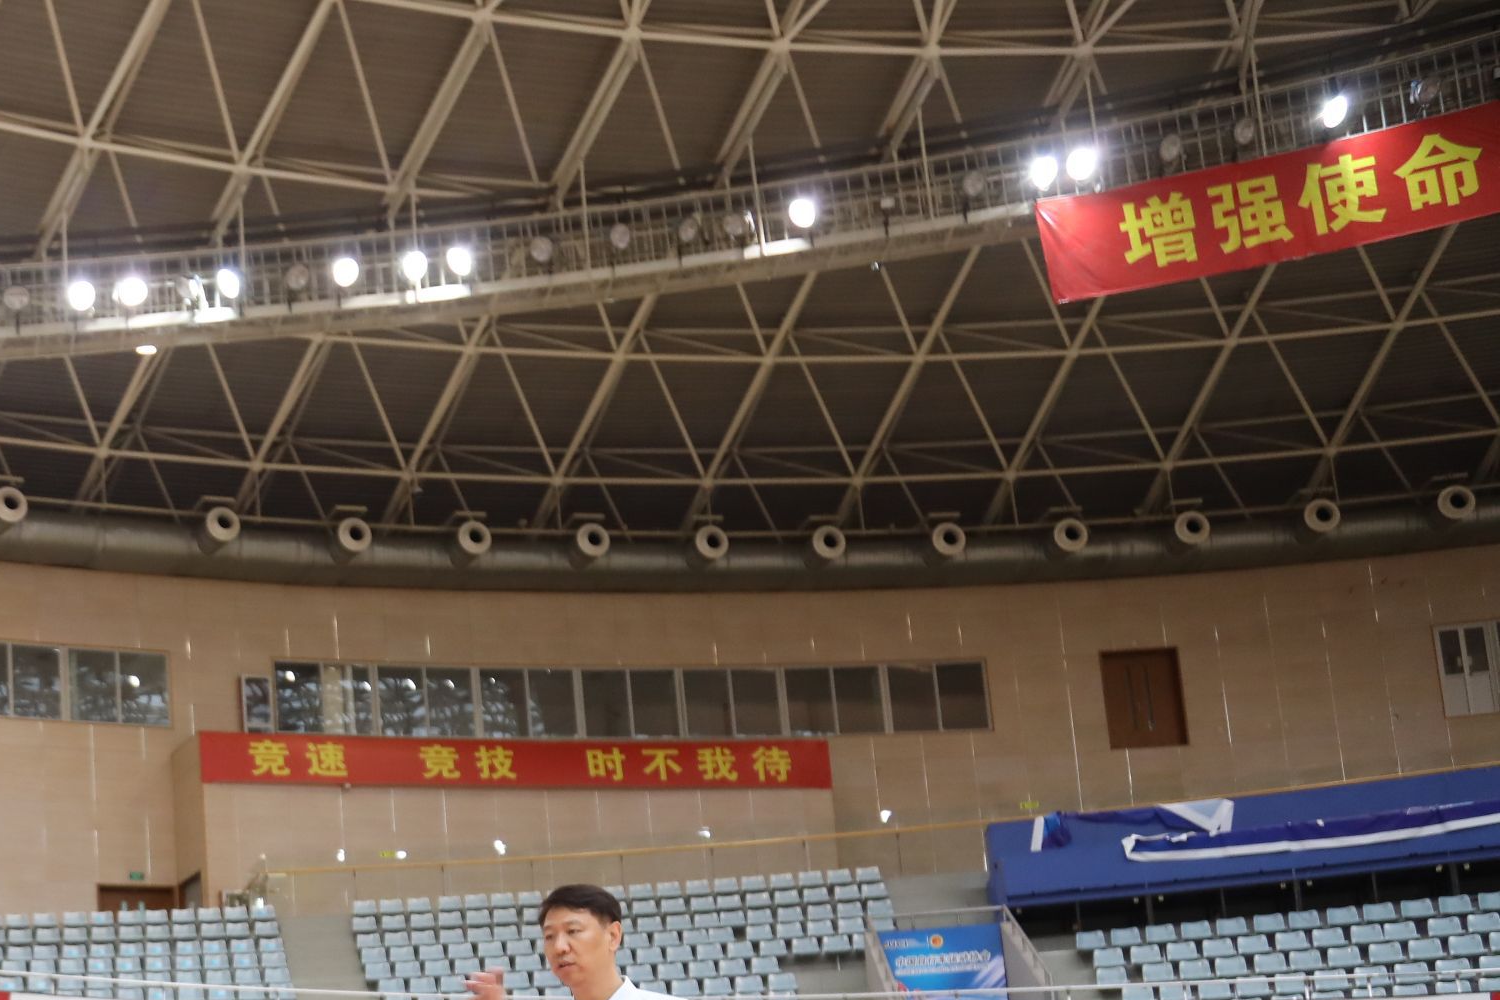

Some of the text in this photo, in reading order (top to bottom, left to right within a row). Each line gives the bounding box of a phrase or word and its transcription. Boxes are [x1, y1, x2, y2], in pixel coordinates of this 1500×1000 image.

[1119, 133, 1483, 267] 增强使命
[248, 739, 793, 782] 竞速 竞技 时不我待
